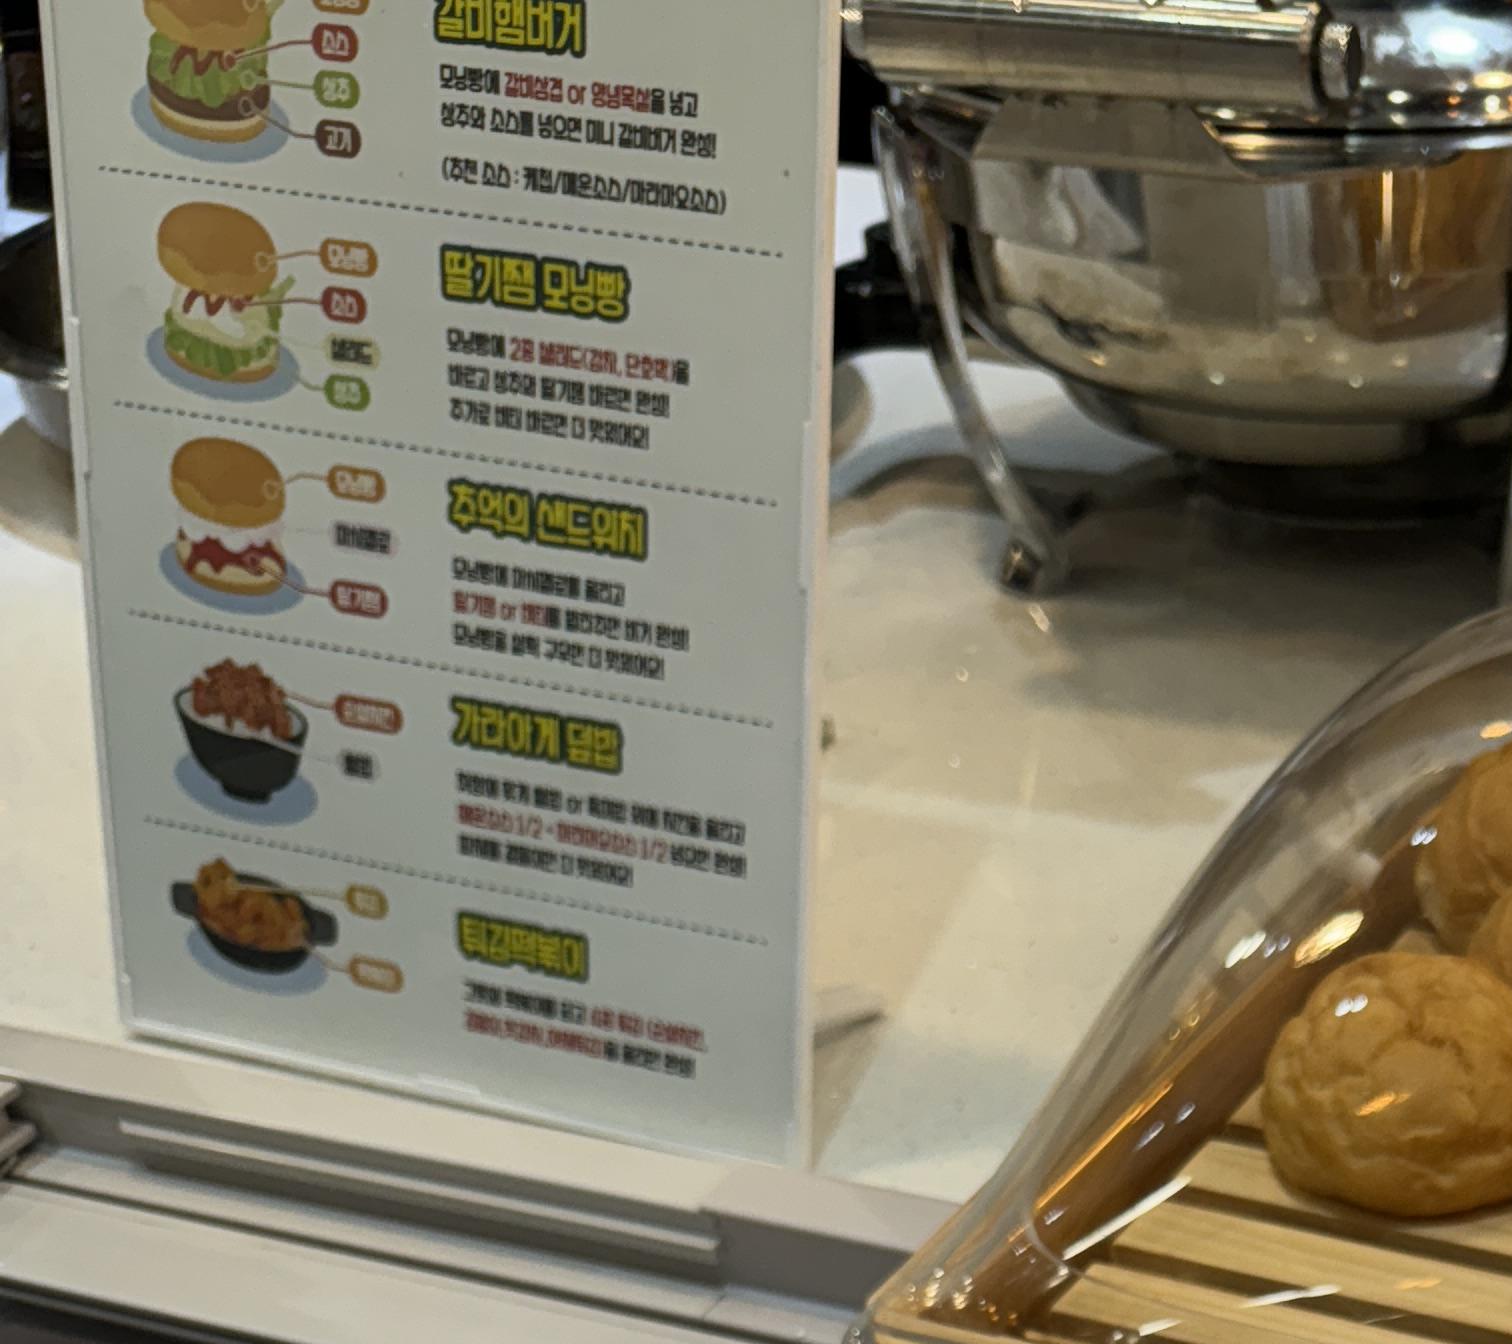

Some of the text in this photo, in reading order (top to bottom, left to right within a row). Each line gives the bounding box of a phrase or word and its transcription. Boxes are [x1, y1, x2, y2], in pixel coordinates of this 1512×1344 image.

[322, 29, 350, 56] 소스
[437, 0, 585, 56] 갈비햄버거
[322, 76, 350, 103] 상추
[439, 64, 501, 96] 모닝빵에
[567, 84, 586, 105] or
[591, 81, 665, 115] 양념목살을
[670, 90, 698, 118] 넣고
[323, 125, 352, 153] 고기
[440, 102, 717, 159] 상추와 소스를 넣으면 미니 갈비버거 완성!
[442, 156, 478, 183] (추천
[482, 161, 511, 188] 소스
[441, 245, 631, 321] 딸기쨈 모닝빵
[447, 327, 505, 359] 모닝빵에
[449, 479, 648, 560] 추억의 샌드위치
[451, 697, 623, 775] 가라아게 덮밥
